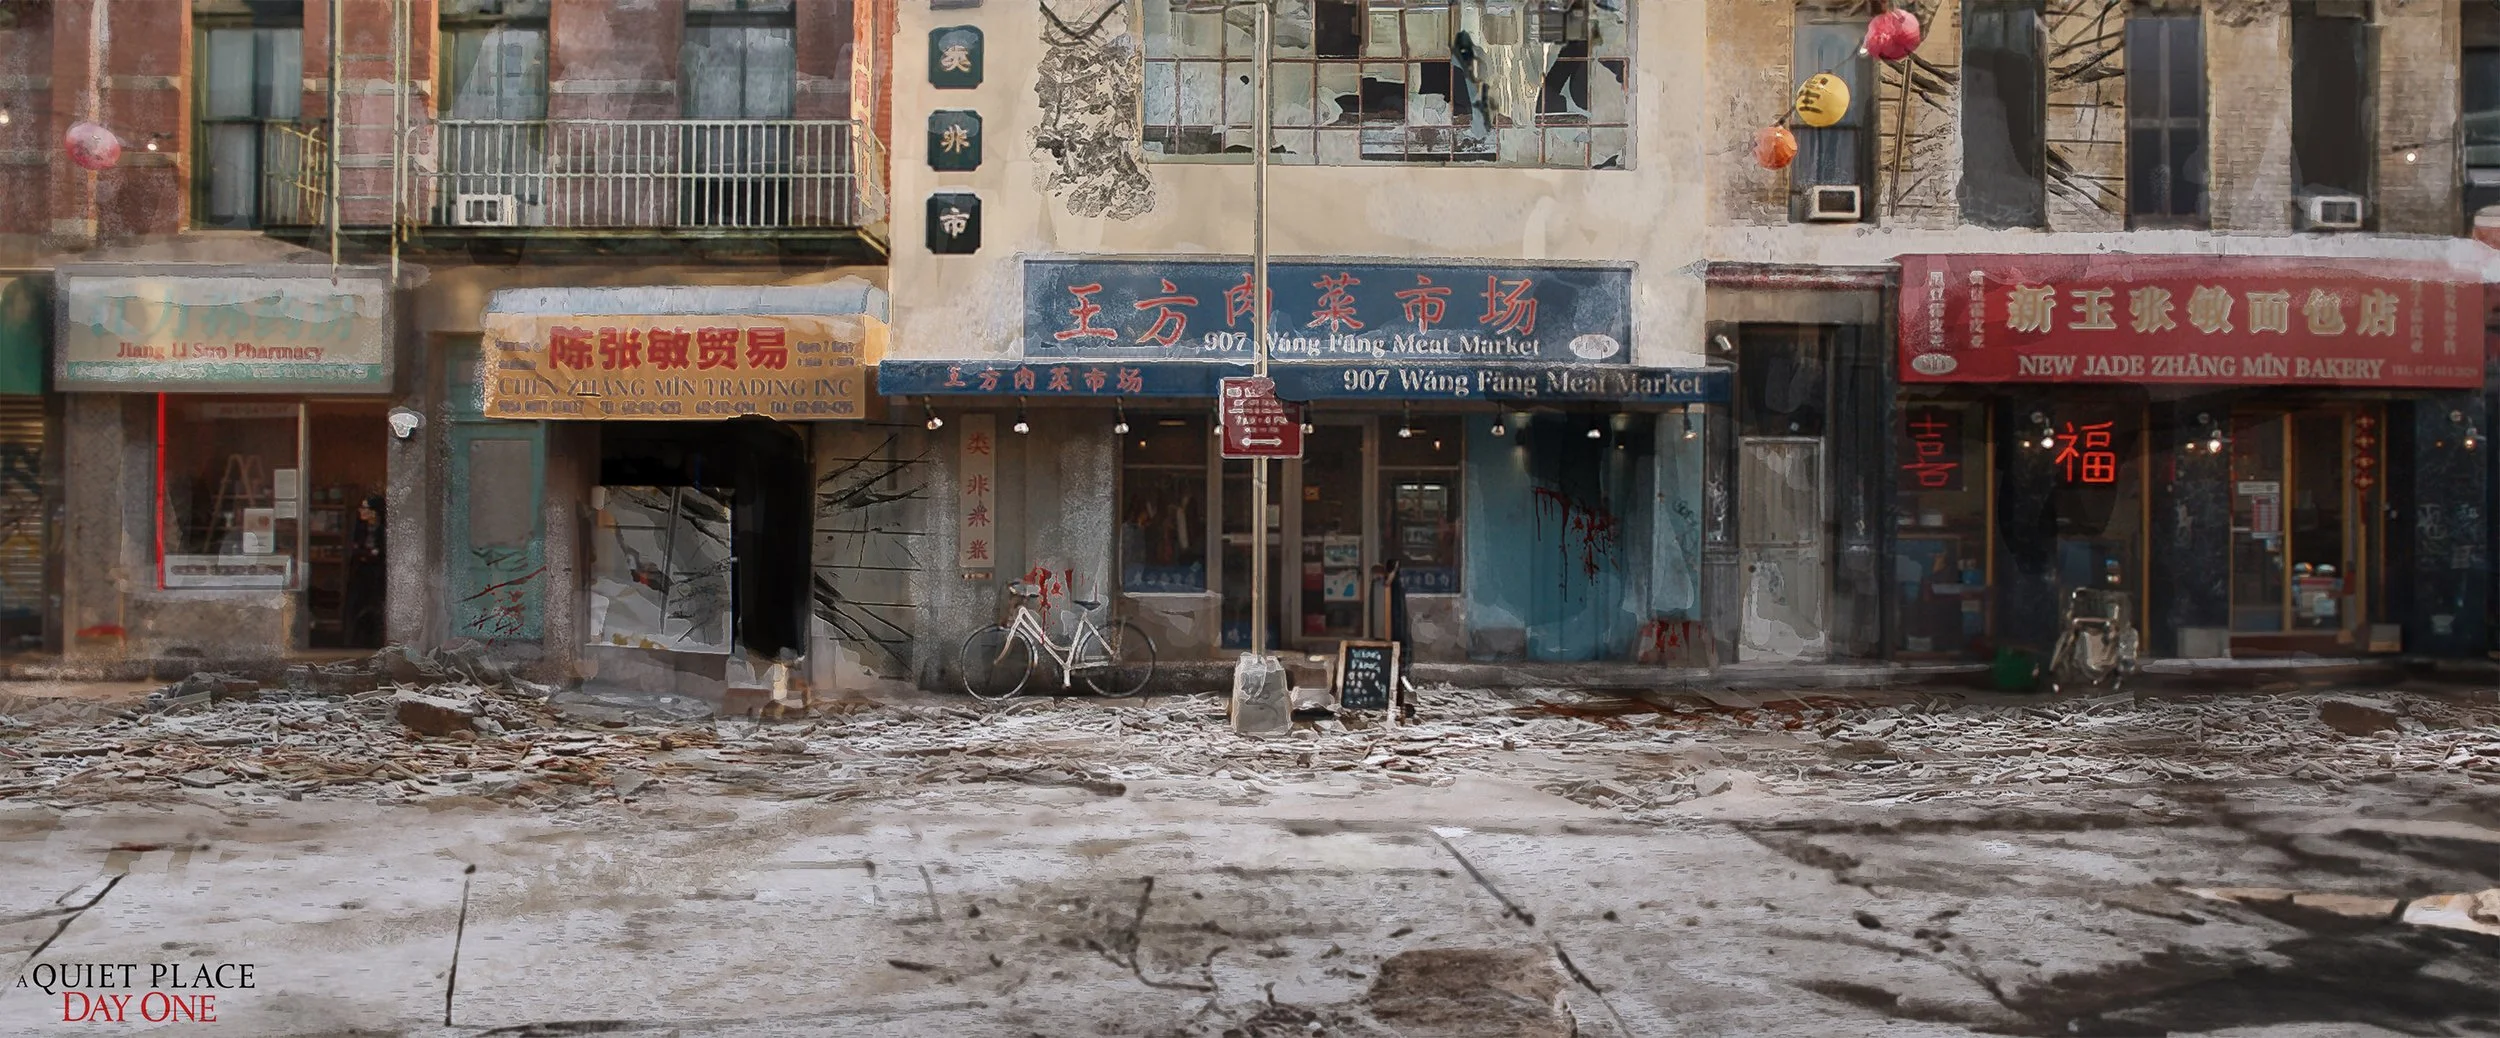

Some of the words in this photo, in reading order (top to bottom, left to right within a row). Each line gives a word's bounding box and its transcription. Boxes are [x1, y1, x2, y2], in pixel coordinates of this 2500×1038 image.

[1054, 272, 1538, 346] 王方肉菜市场
[2006, 284, 2399, 336] 新玉张敏面包店
[234, 342, 325, 361] Pharmacy
[548, 326, 789, 371] 陈张敏贸易
[1204, 332, 1246, 351] 907
[1393, 334, 1449, 354] Meat
[1460, 335, 1540, 355] Market
[1343, 369, 1389, 391] 907
[1547, 371, 1607, 393] Meat
[1616, 372, 1703, 395] Market
[2018, 355, 2077, 376] NEW
[2083, 355, 2145, 376] JADE
[2295, 358, 2385, 379] BAKERY
[704, 376, 806, 397] TRADING
[815, 378, 853, 397] INC
[1902, 412, 1960, 488] 喜
[2055, 421, 2116, 484] 福
